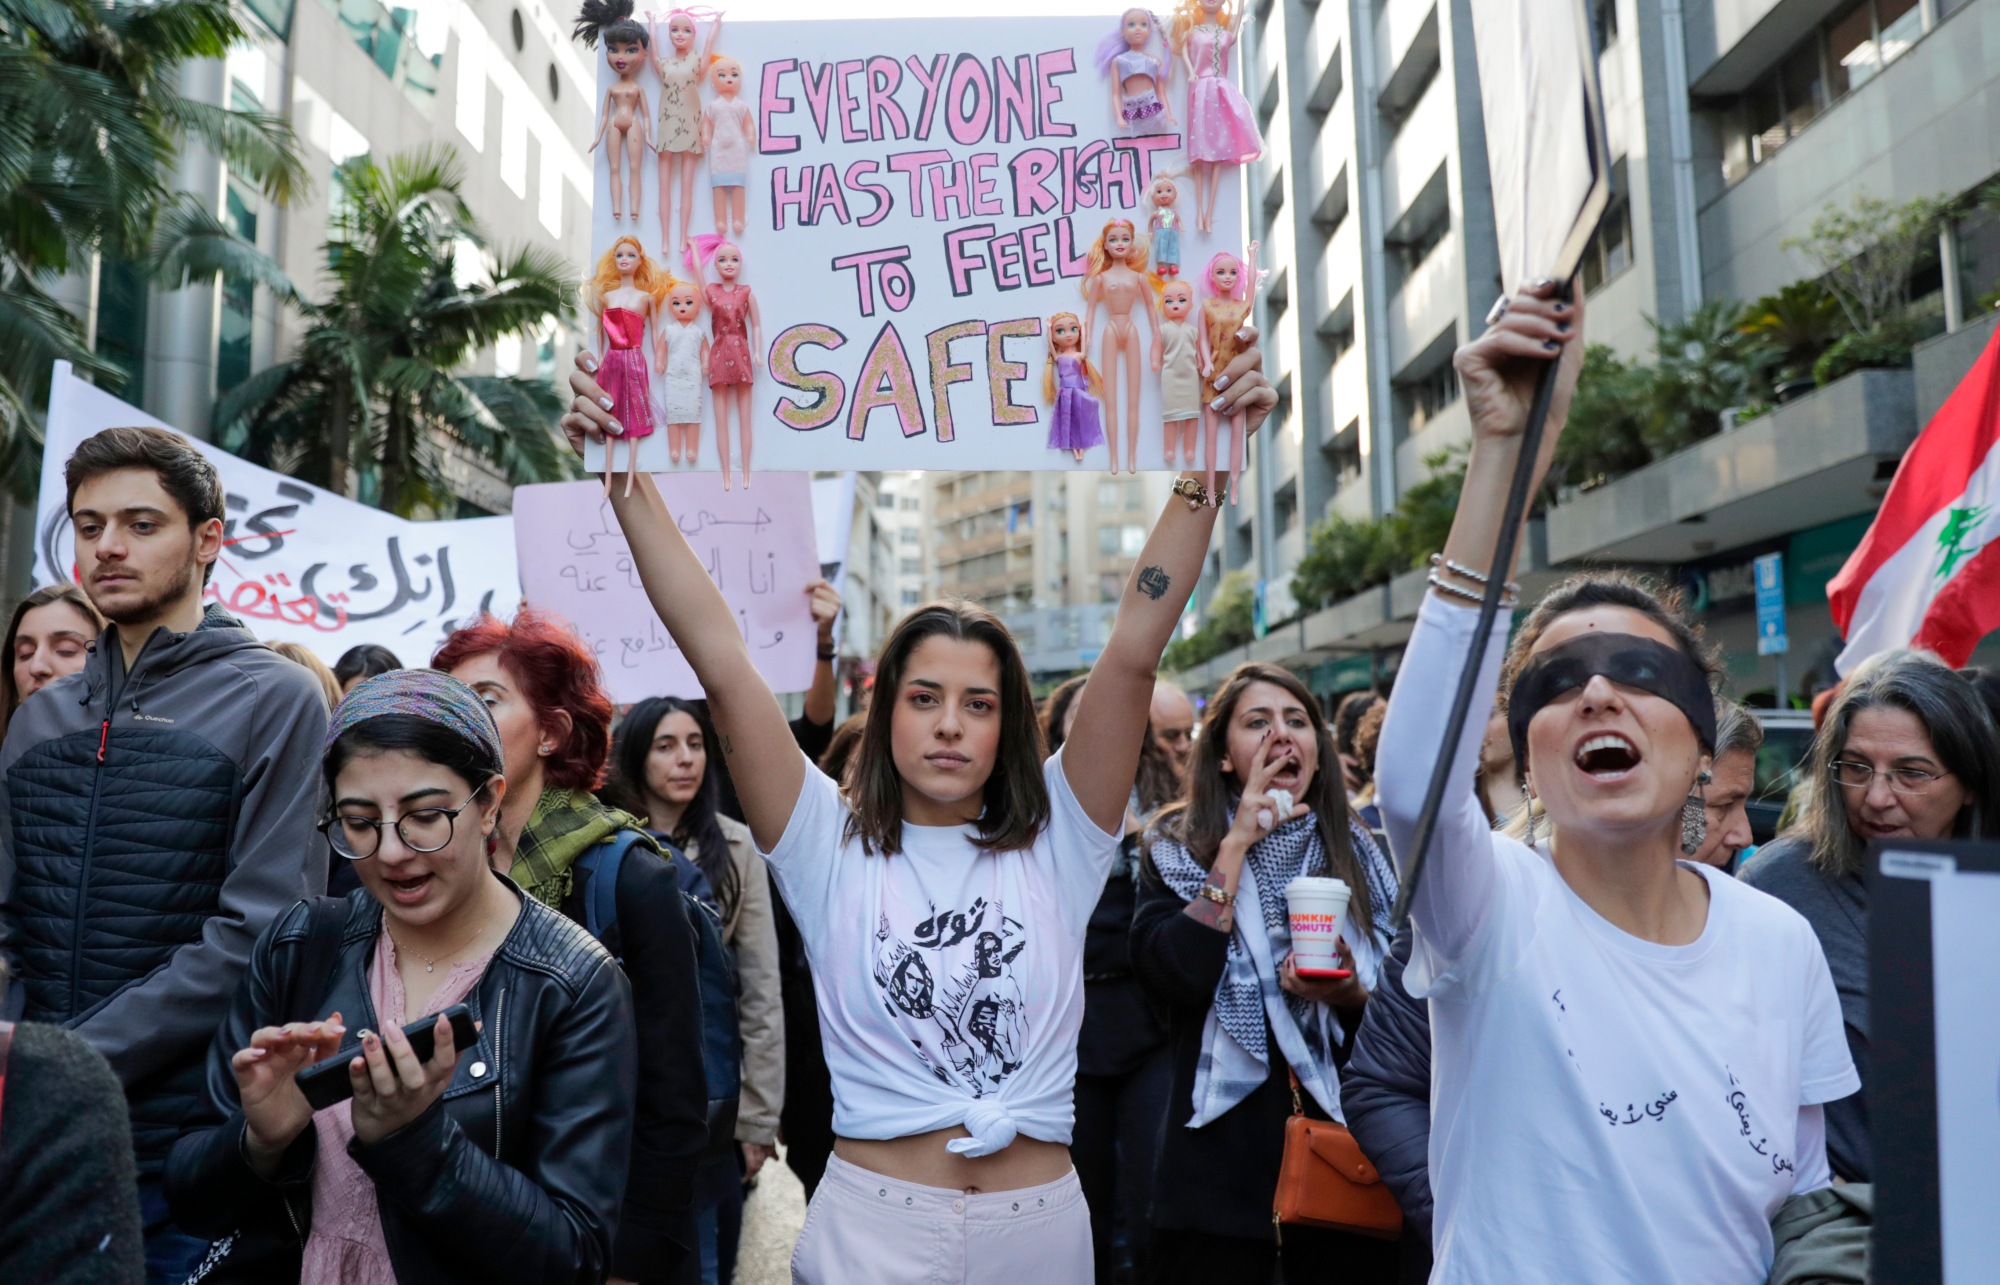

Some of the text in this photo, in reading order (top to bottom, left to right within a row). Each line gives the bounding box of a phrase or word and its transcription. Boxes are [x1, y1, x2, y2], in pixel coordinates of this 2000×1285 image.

[760, 48, 1077, 155] EVERYONE
[771, 134, 1181, 231] HAS THE RIGHT
[832, 216, 1090, 317] TO FEEL
[767, 317, 1042, 443] SAFE
[144, 714, 175, 724] Quechua
